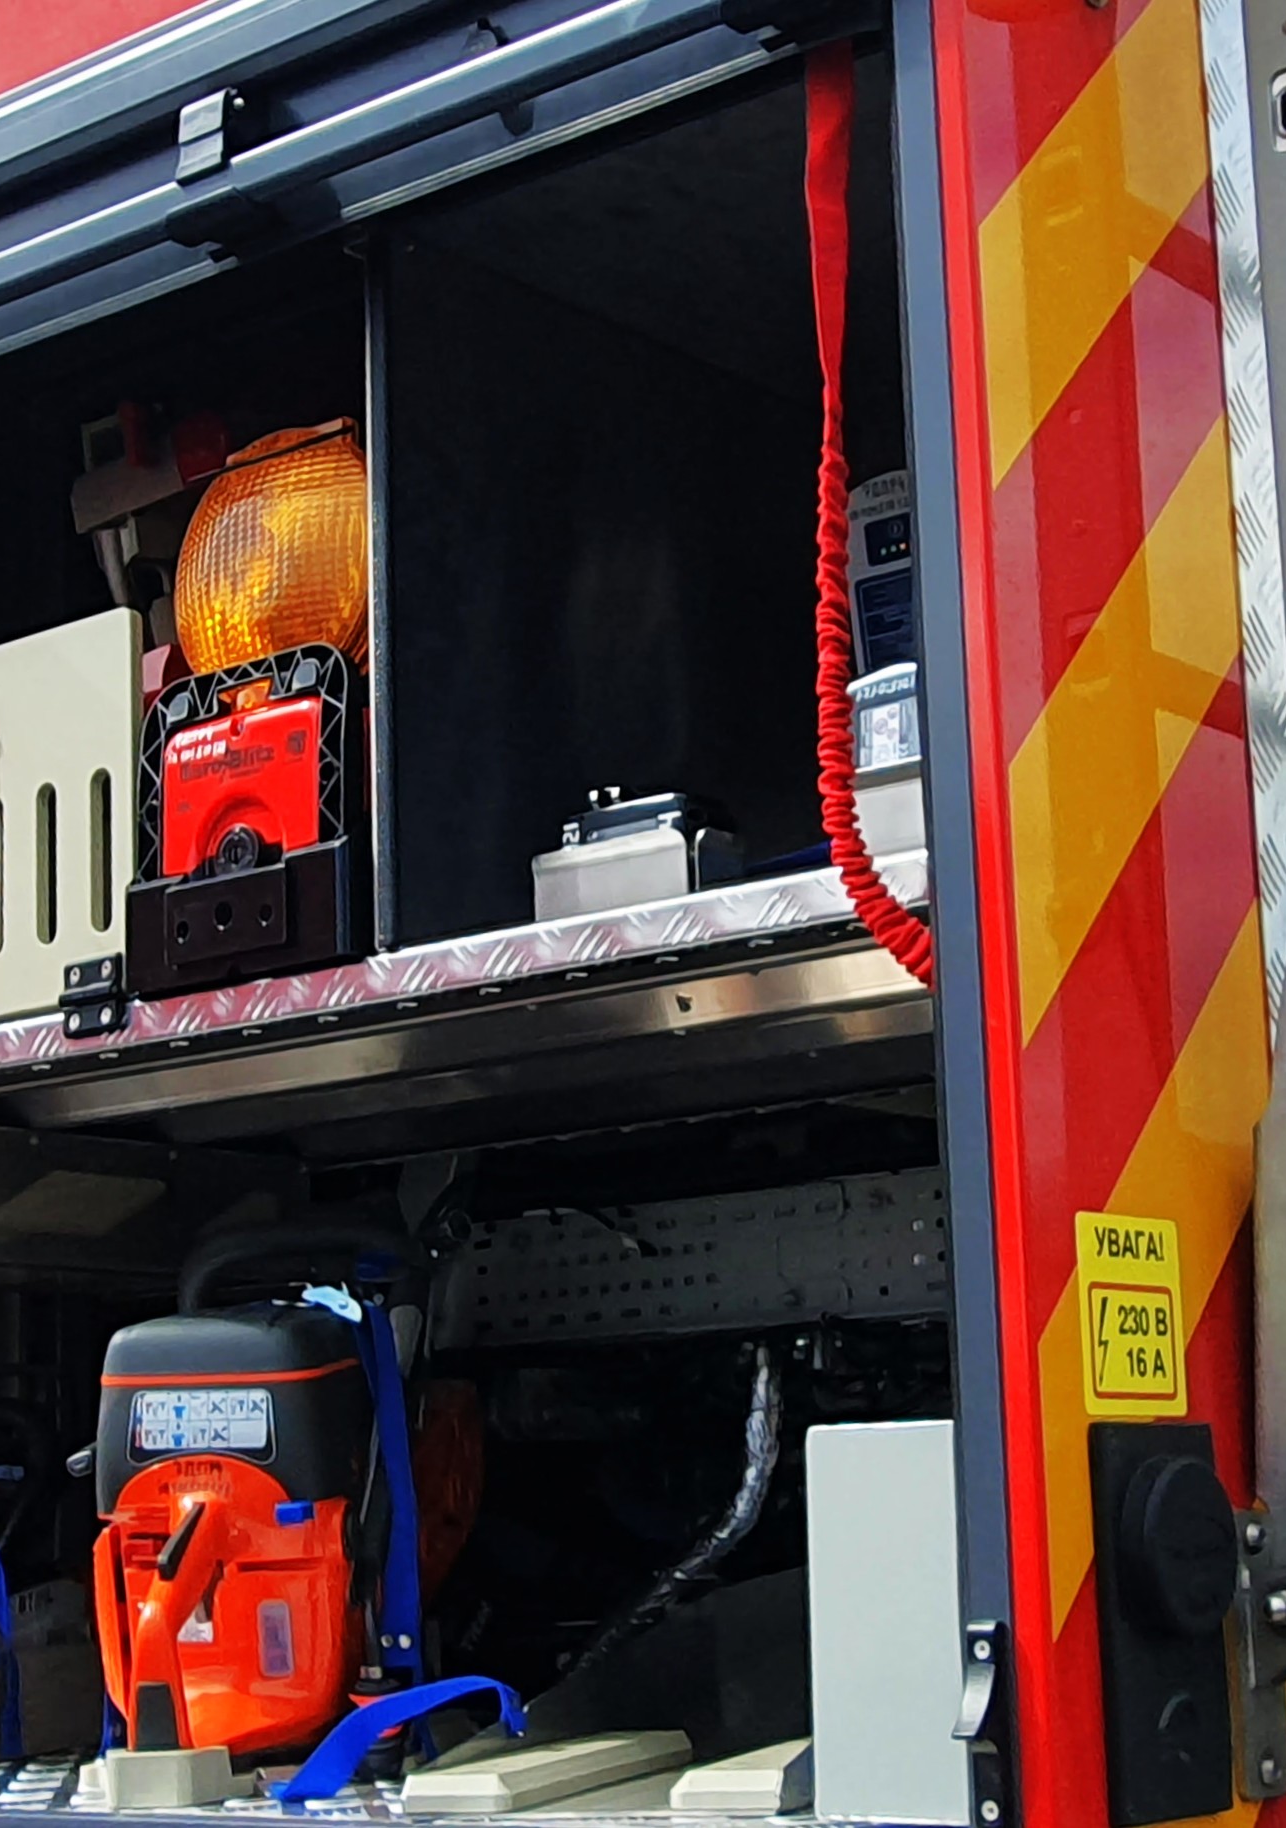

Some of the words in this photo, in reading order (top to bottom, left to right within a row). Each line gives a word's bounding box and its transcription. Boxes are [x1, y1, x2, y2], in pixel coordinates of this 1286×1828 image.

[1094, 1225, 1165, 1262] УВАГА!
[1117, 1304, 1150, 1337] 230
[1126, 1347, 1147, 1378] 16
